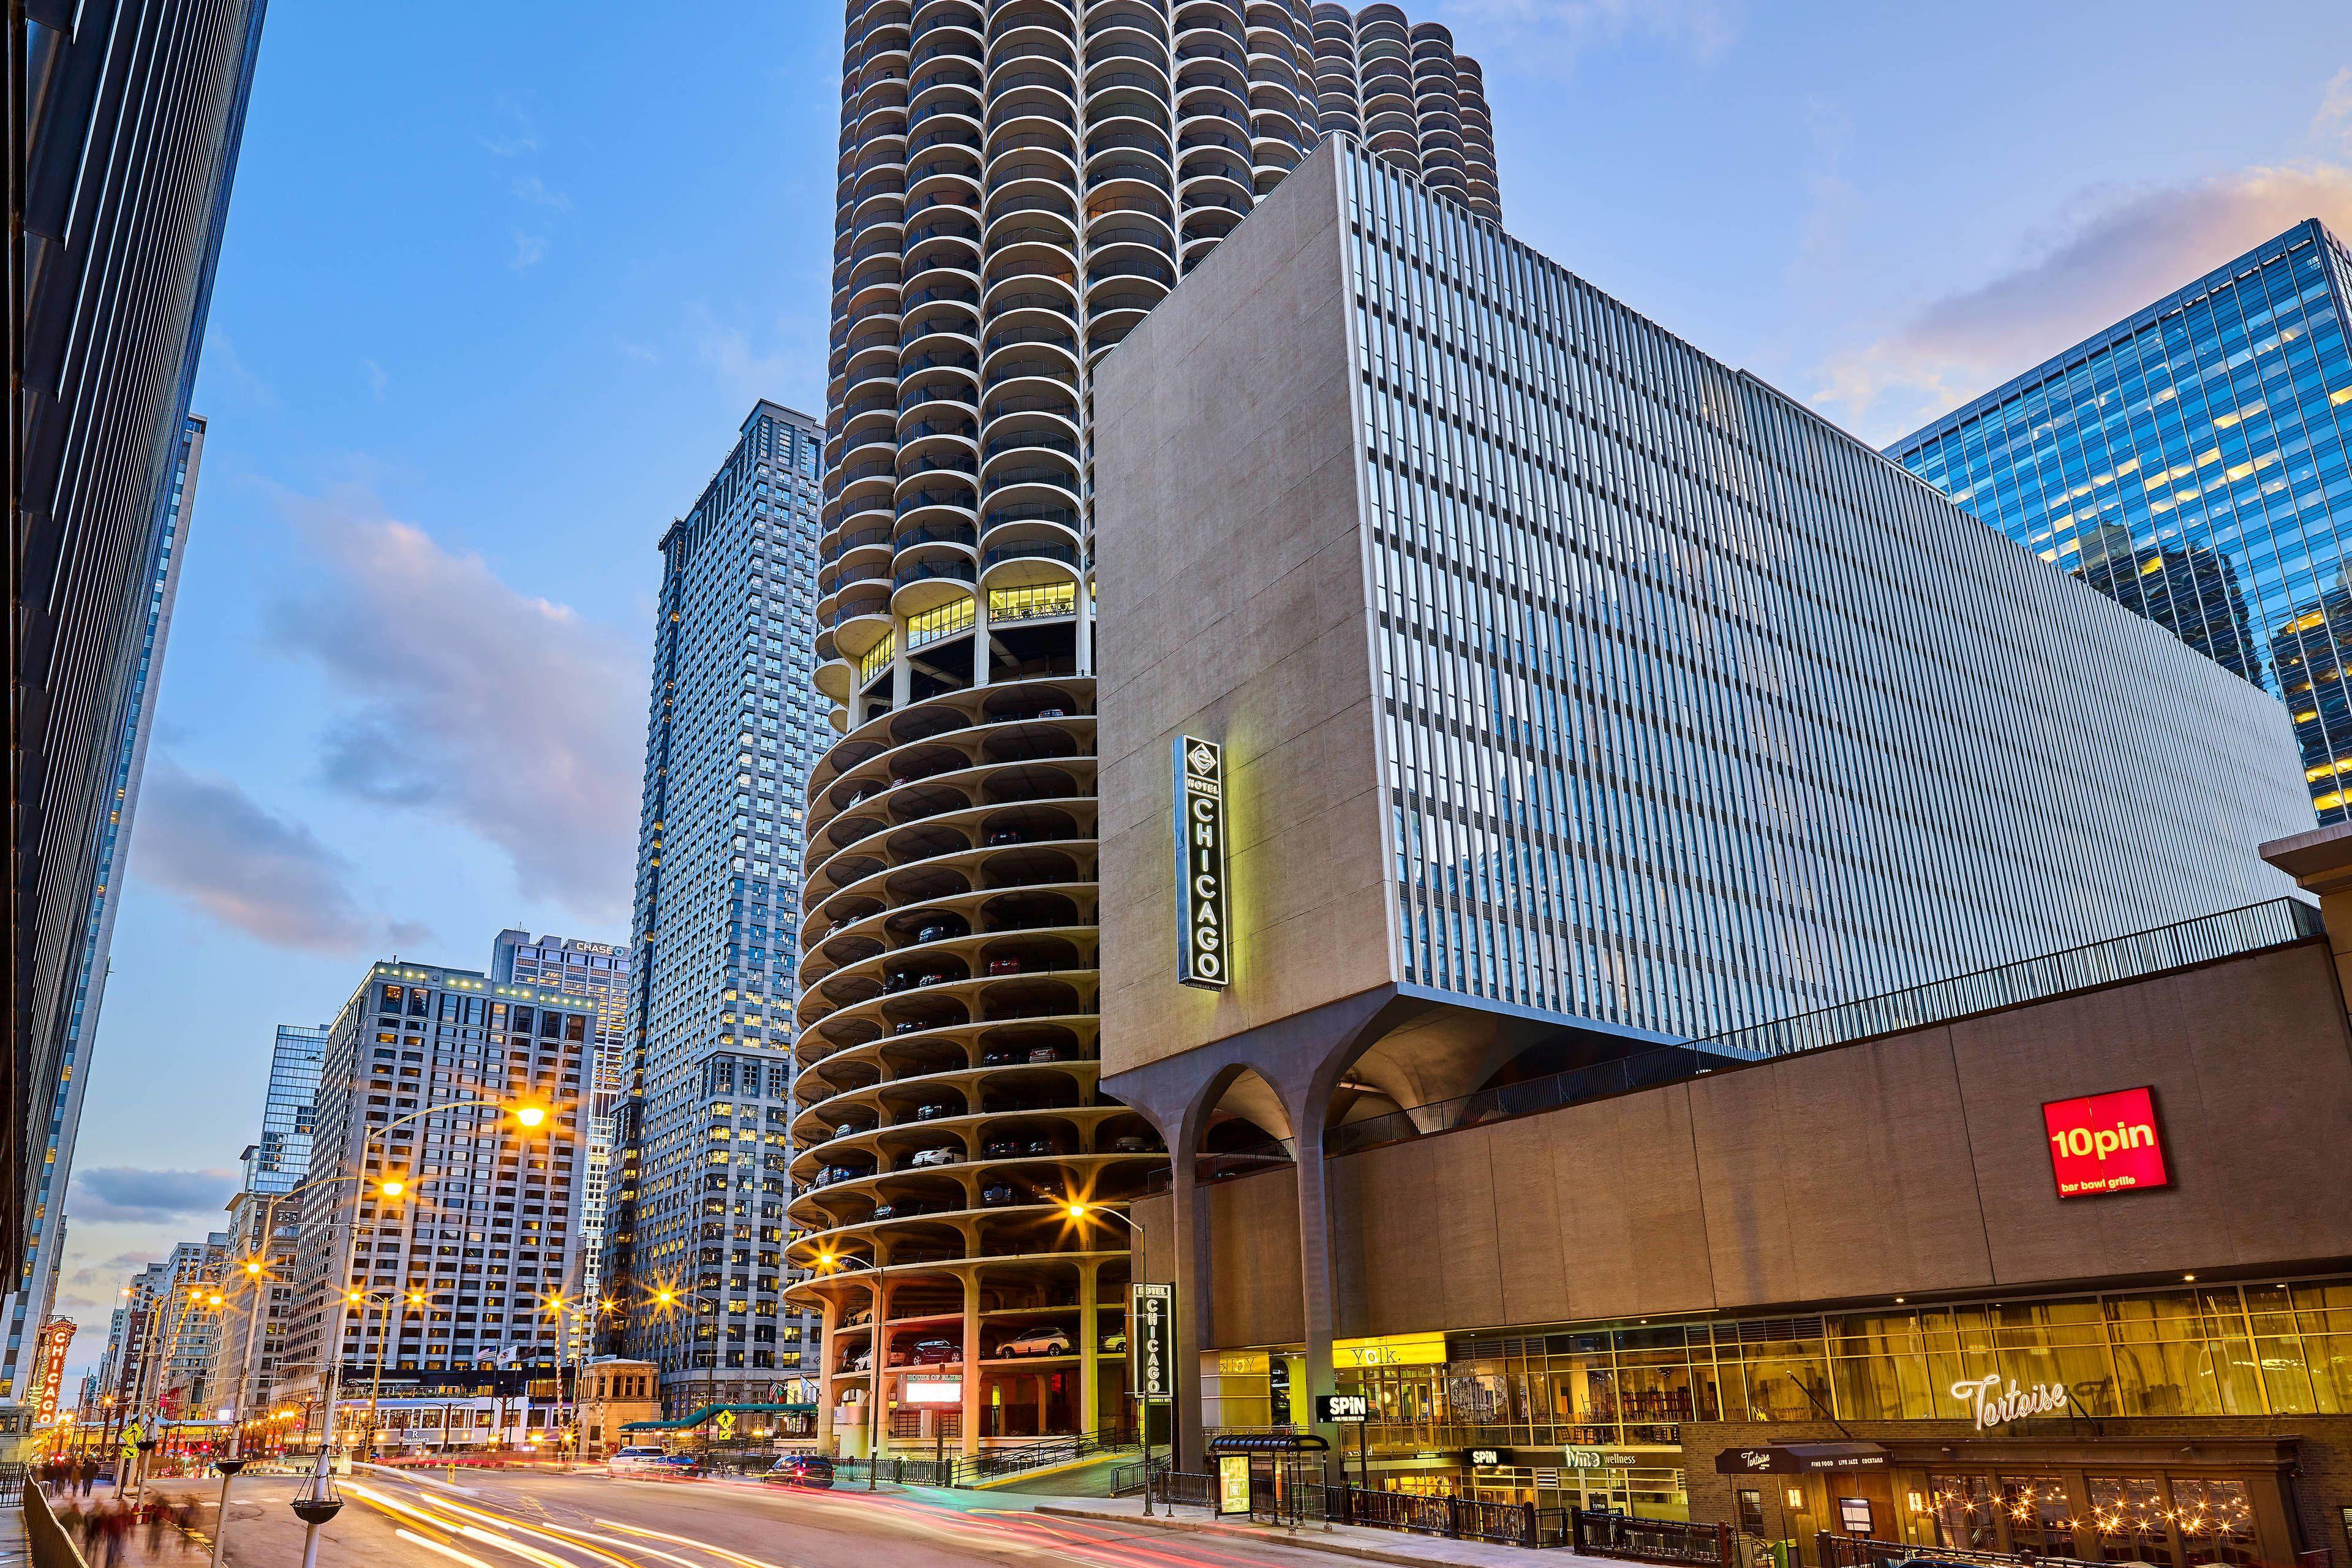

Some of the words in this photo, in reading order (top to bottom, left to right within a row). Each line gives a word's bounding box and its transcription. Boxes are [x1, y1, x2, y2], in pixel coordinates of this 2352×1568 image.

[1188, 778, 1219, 794] HOTEL
[1194, 798, 1220, 978] CHICAGO
[576, 943, 613, 955] CHASE
[2052, 1121, 2154, 1160] 10pin
[2061, 1182, 2079, 1192] bar
[2081, 1179, 2106, 1189] bowl
[2108, 1175, 2136, 1189] grille
[1138, 1287, 1166, 1295] HOTEL
[1147, 1299, 1160, 1393] CHICAGO
[1351, 1347, 1401, 1365] Yolk.
[39, 1332, 67, 1424] CHICAGO
[1951, 1374, 2068, 1430] Tortoise
[1604, 1455, 1636, 1464] wellness
[1741, 1451, 1770, 1468] Tortoise
